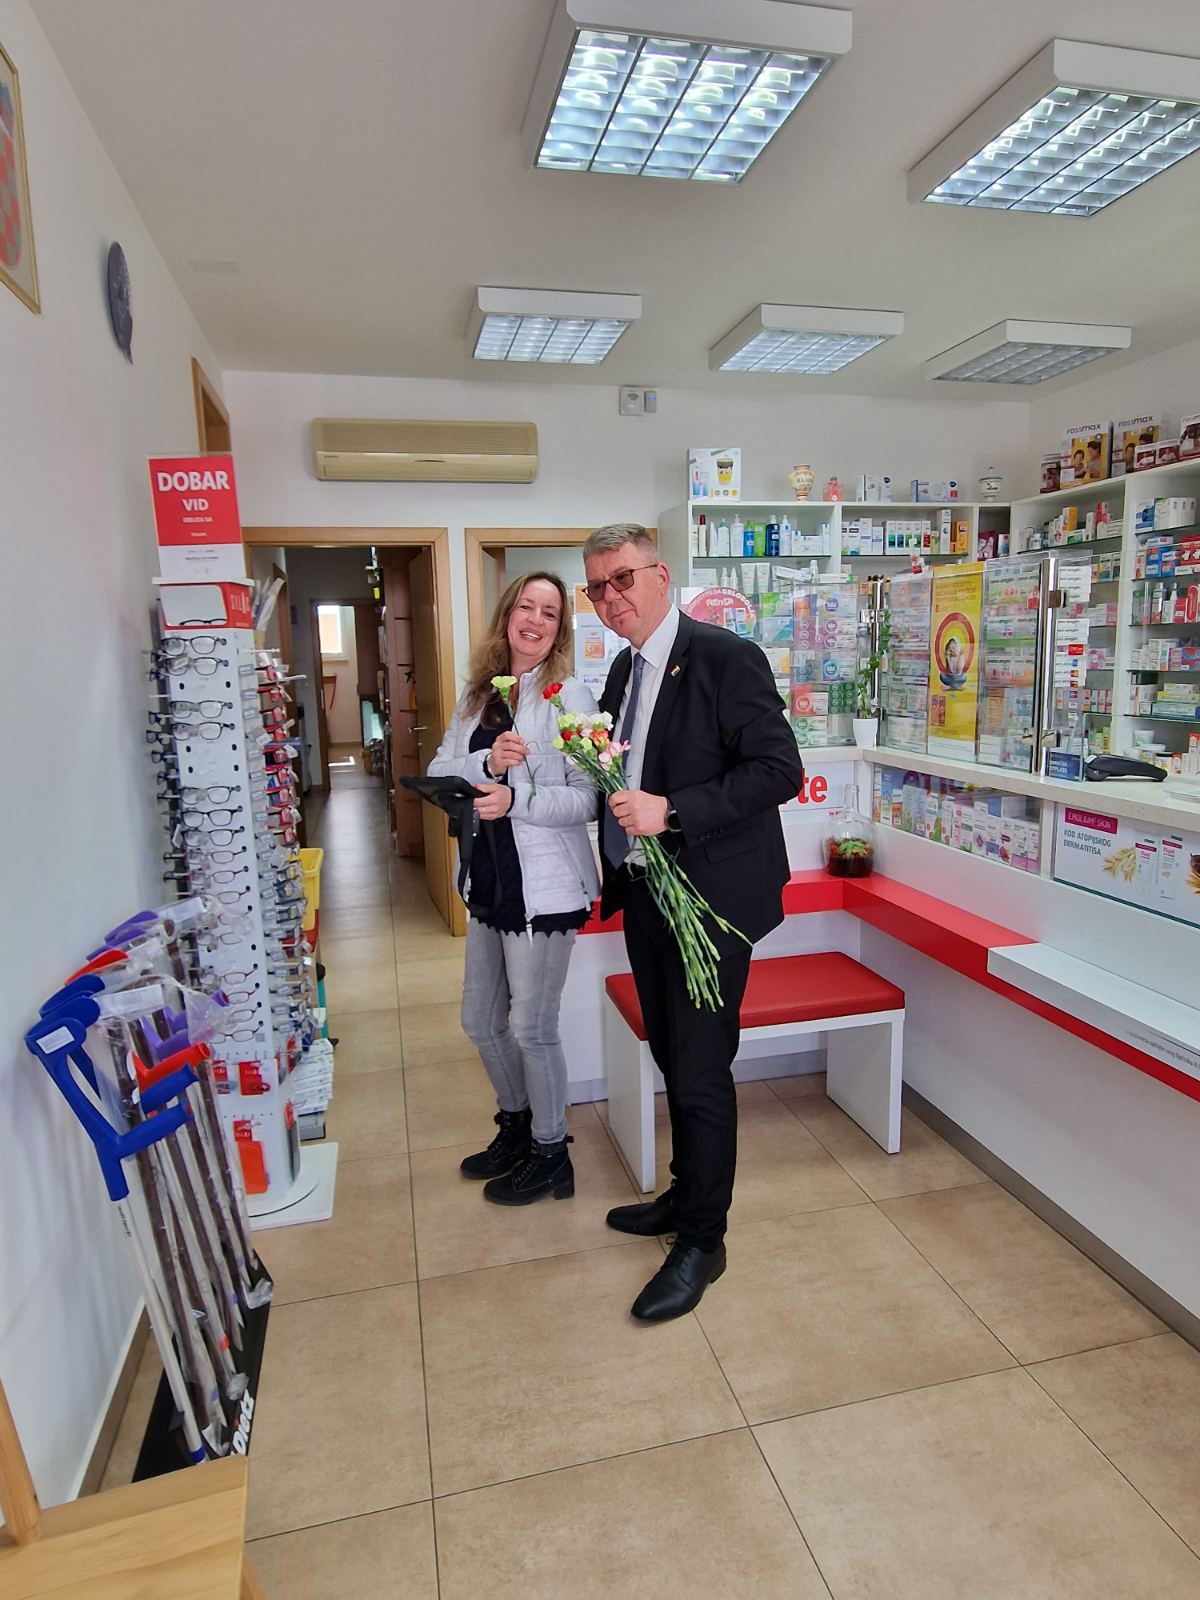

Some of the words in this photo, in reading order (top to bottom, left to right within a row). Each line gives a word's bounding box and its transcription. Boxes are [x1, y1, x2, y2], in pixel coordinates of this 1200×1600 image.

[1066, 423, 1102, 435] rossmax
[1119, 415, 1154, 428] rossmax
[156, 470, 231, 492] DOBAR
[182, 498, 209, 512] VID
[1063, 828, 1077, 838] KOD
[1076, 832, 1113, 849] ATOPIJSKOG
[1063, 838, 1102, 857] DERMATITISA
